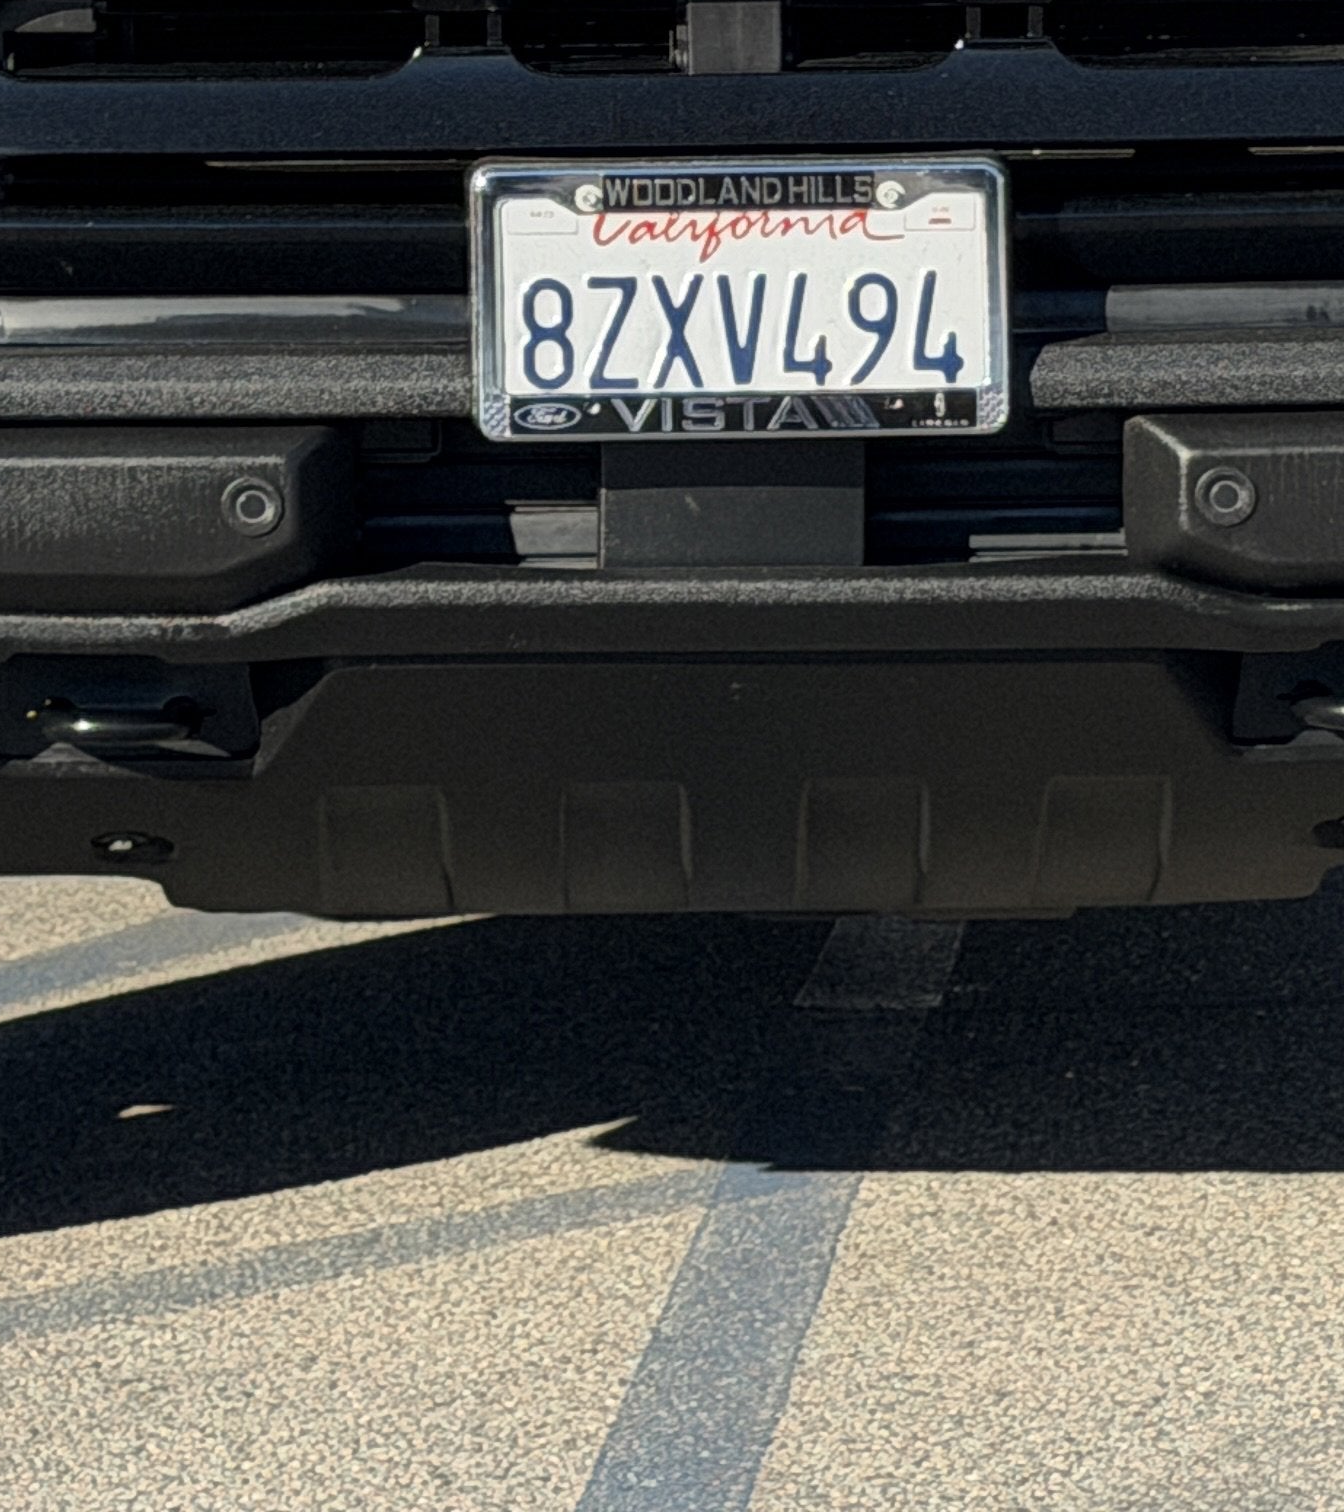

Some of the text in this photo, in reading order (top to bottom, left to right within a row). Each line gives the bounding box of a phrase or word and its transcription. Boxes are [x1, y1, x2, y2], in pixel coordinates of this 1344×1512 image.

[605, 174, 873, 207] WOODLAND HILLS
[521, 268, 965, 391] 8ZXV494
[526, 405, 568, 425] Ford
[610, 395, 819, 432] VISTA
